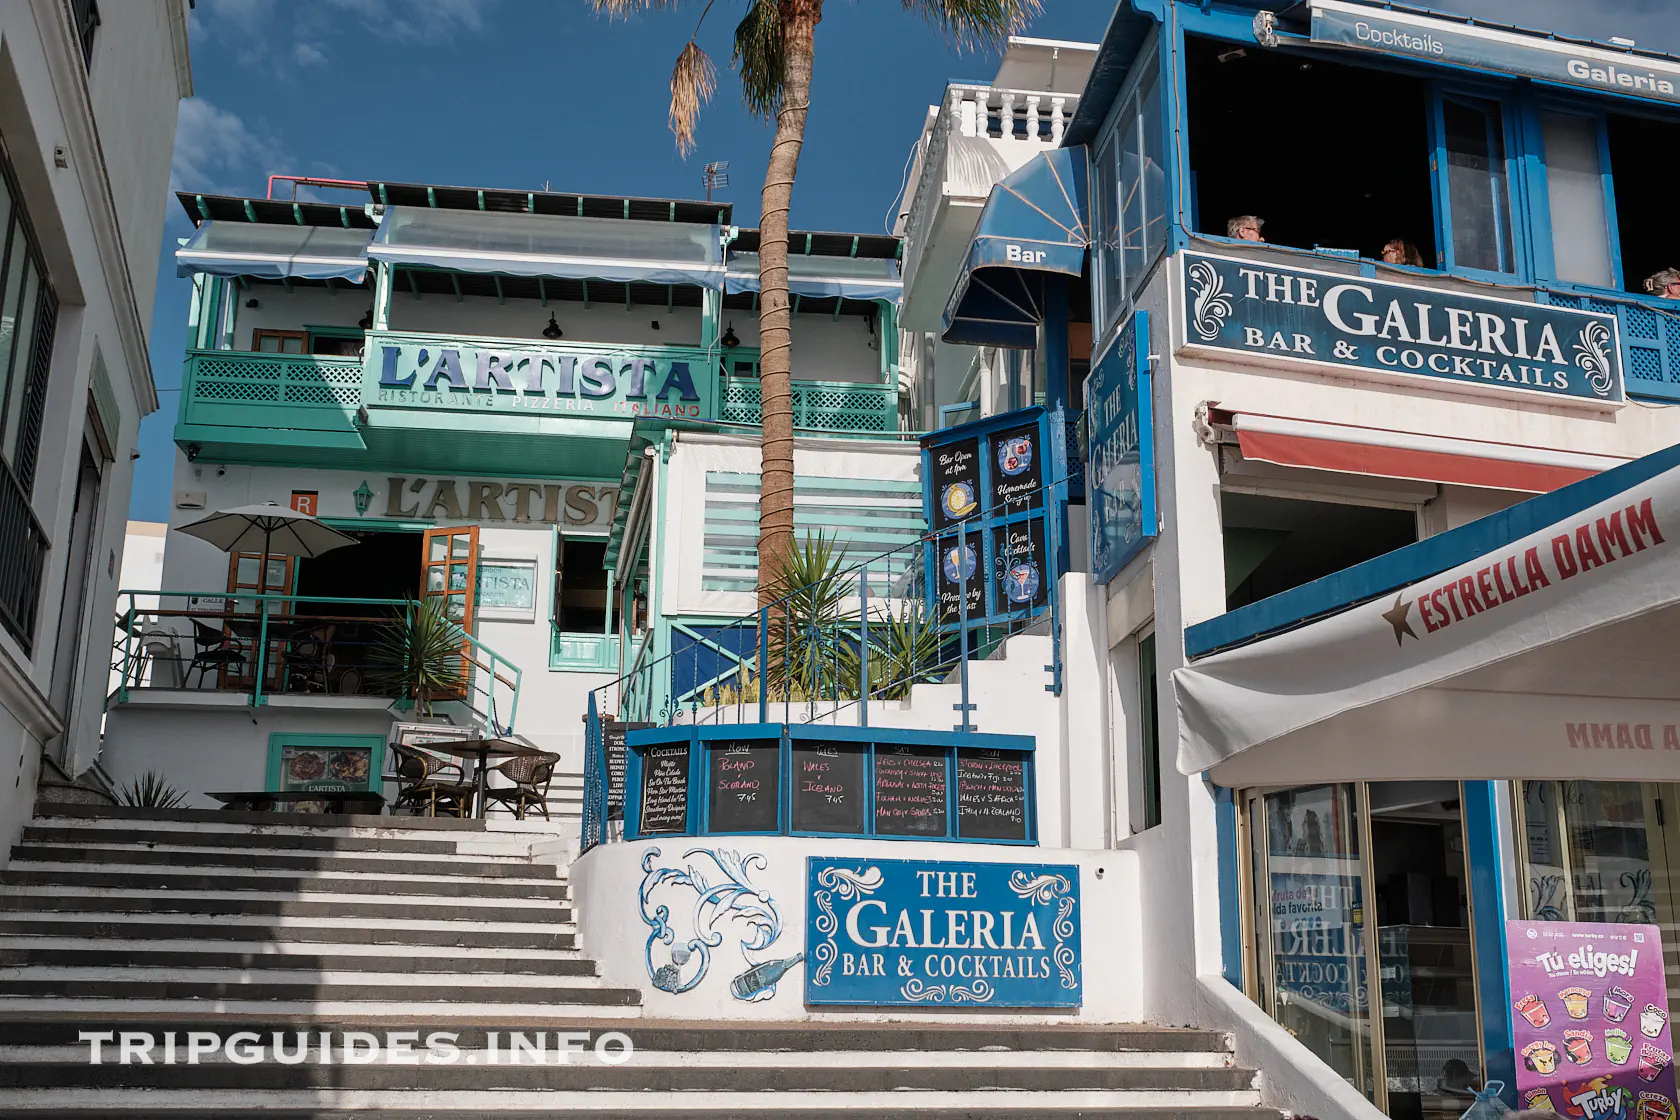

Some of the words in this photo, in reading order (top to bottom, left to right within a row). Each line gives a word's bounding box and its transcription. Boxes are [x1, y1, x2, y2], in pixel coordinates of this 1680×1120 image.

[1355, 22, 1443, 55] Cocktails
[1567, 59, 1675, 96] Galeria
[1006, 244, 1046, 263] Bar
[1239, 268, 1320, 308] THE
[1322, 284, 1569, 365] GALERIA
[1243, 327, 1316, 354] BAR
[1333, 340, 1359, 360] &
[1376, 346, 1569, 390] COCKTAILS
[378, 346, 700, 401] L'ARTISTA
[378, 389, 494, 407] RISTORANTE
[512, 396, 594, 412] PIZZERIA
[614, 401, 700, 417] ITALIANO
[1104, 383, 1122, 429] THE
[939, 454, 952, 466] Bar
[954, 450, 972, 464] Open
[1091, 408, 1138, 490] GALERIA
[945, 466, 953, 475] at
[997, 478, 1037, 495] Homemade
[297, 496, 310, 514] R
[1010, 532, 1028, 545] Cava
[1418, 546, 1552, 634] ESTRELLA
[1551, 497, 1666, 581] DAMM
[802, 780, 843, 793] ICELAND
[916, 870, 978, 898] THE
[845, 900, 1046, 950] GALERIA
[842, 953, 887, 976] BAR
[897, 955, 914, 977] &
[924, 954, 1051, 979] COCKTAILS
[1568, 944, 1638, 978] eliges!
[1515, 994, 1535, 1010] Fresa
[1613, 985, 1635, 1003] Mora
[1647, 1003, 1667, 1019] Coco
[1638, 1090, 1669, 1105] Cereza
